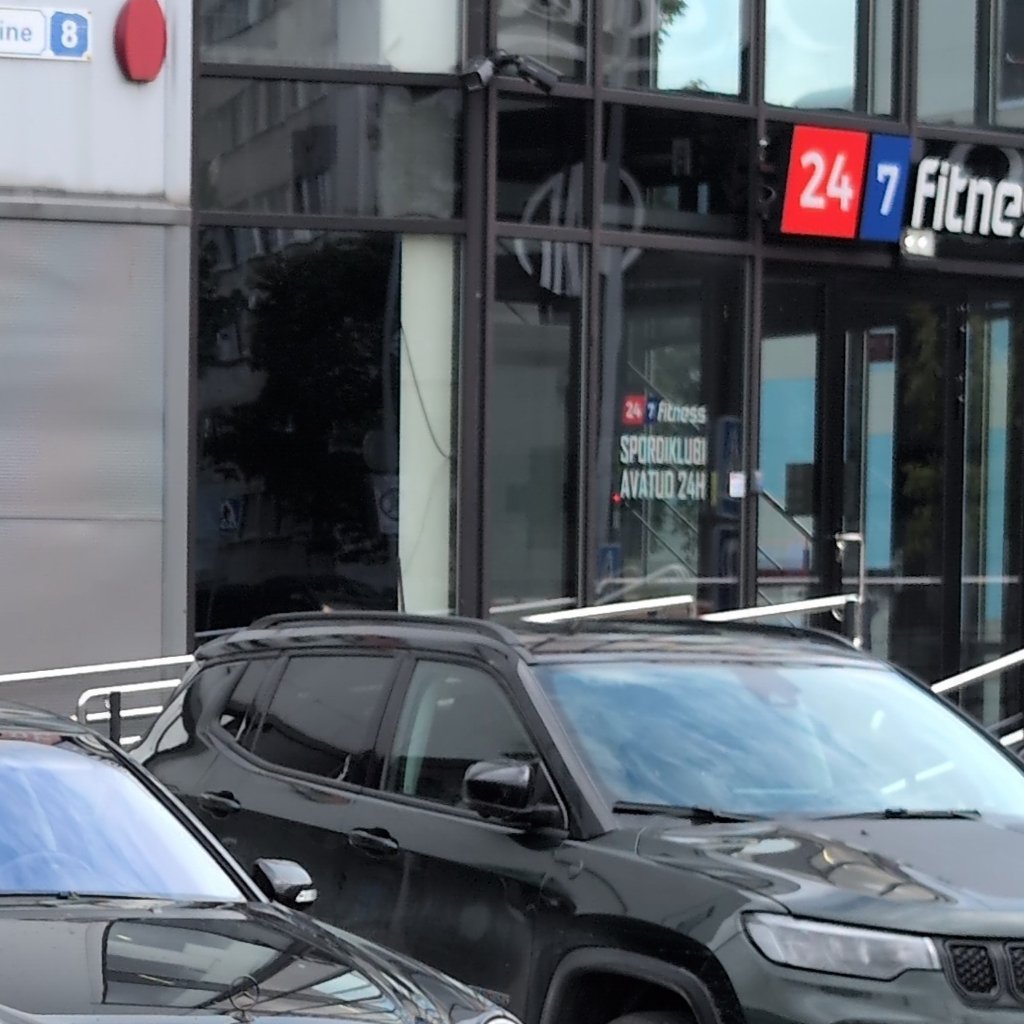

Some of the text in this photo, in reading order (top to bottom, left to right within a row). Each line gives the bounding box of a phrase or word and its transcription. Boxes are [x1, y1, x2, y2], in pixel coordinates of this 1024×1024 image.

[61, 19, 78, 49] 8
[799, 150, 1024, 239] 24 7 Fitne
[625, 401, 643, 419] 24
[620, 434, 706, 466] SPORDIKLUBI
[620, 469, 706, 501] AVATUD 24H
